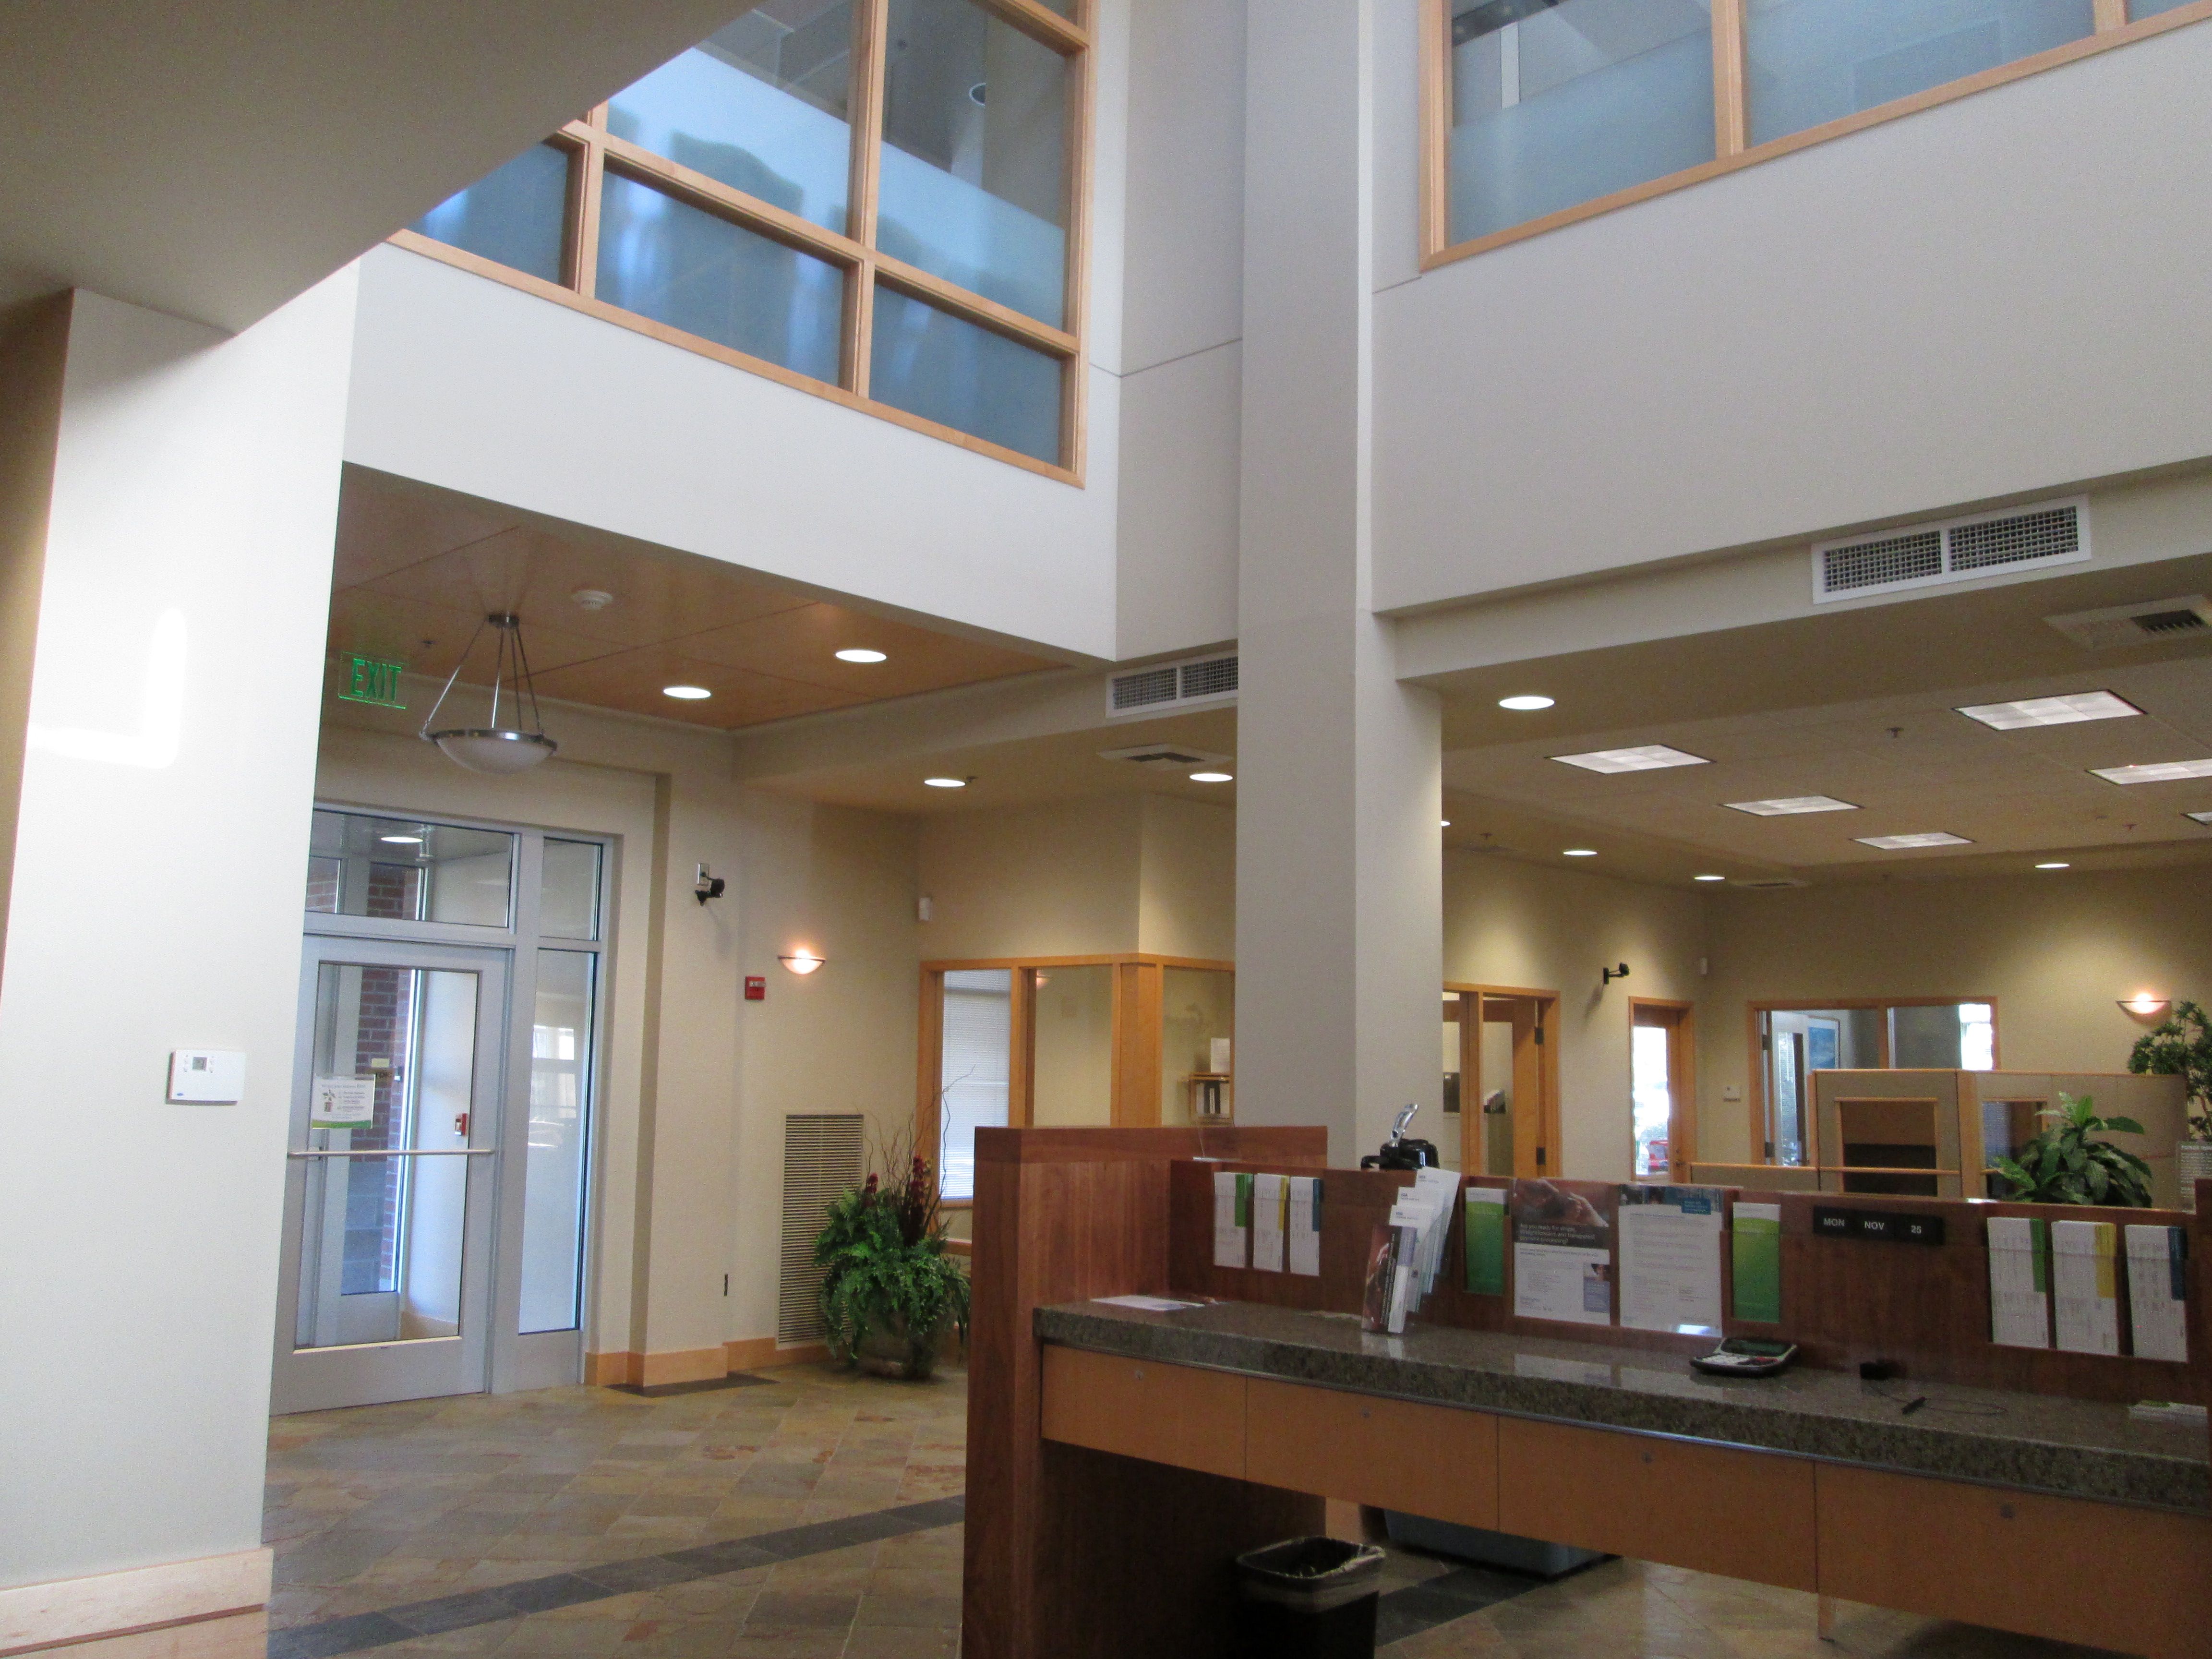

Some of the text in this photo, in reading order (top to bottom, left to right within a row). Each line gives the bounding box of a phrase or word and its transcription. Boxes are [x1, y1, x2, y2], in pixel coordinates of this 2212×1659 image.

[350, 658, 402, 702] EXIT
[1823, 1217, 1845, 1227] MON
[1864, 1221, 1885, 1230] NOV
